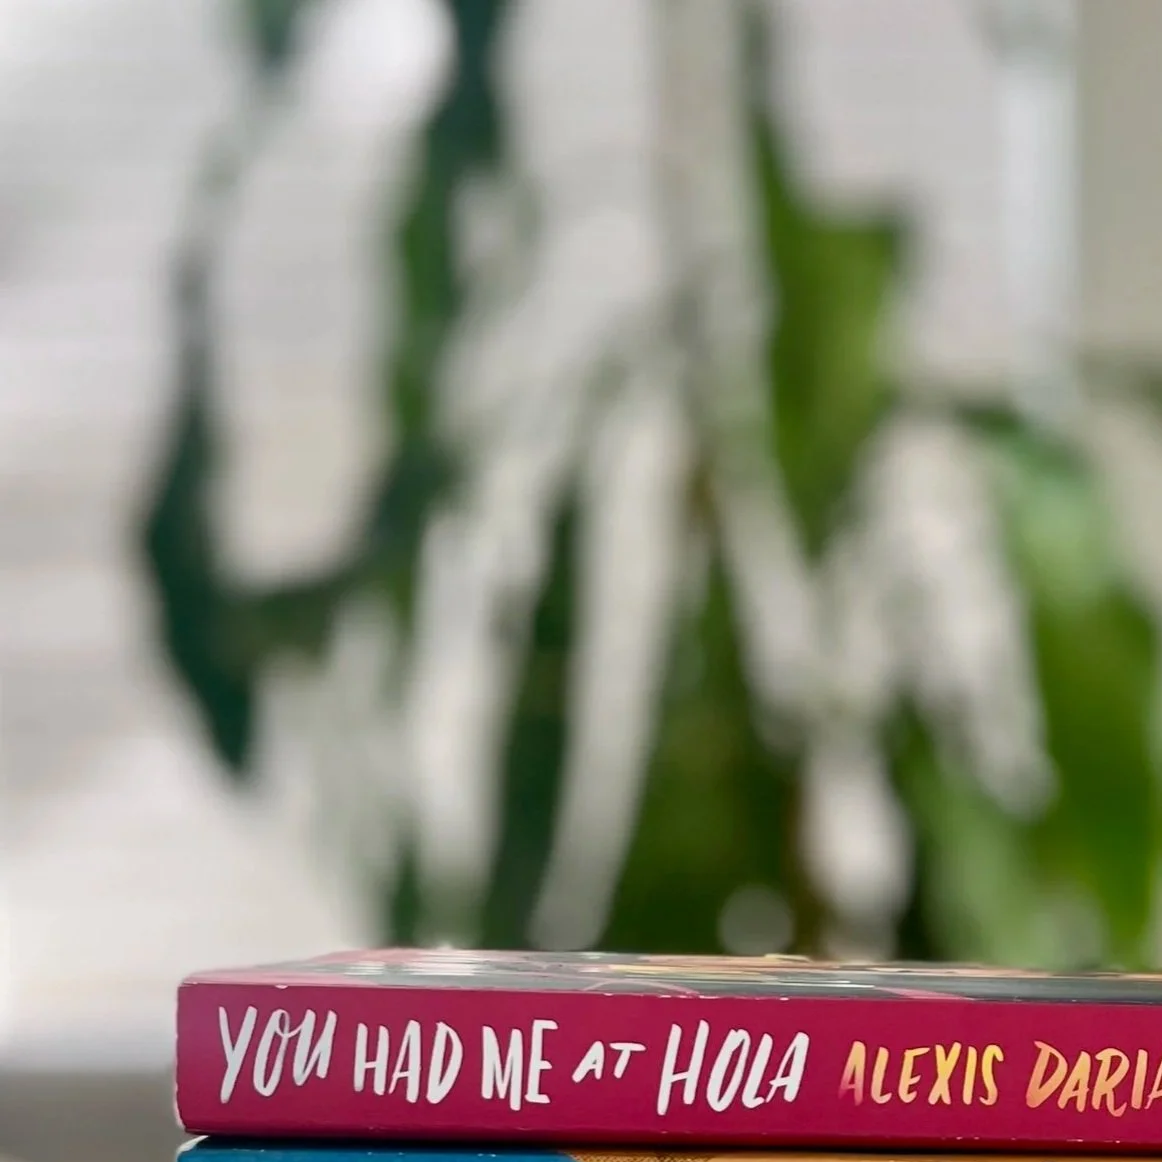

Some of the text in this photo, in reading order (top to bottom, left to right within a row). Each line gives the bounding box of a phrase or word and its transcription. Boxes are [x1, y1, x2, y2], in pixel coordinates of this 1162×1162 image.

[219, 1006, 810, 1116] YOU HAD ME AT HOLA
[839, 1041, 1004, 1107] ALEXIS
